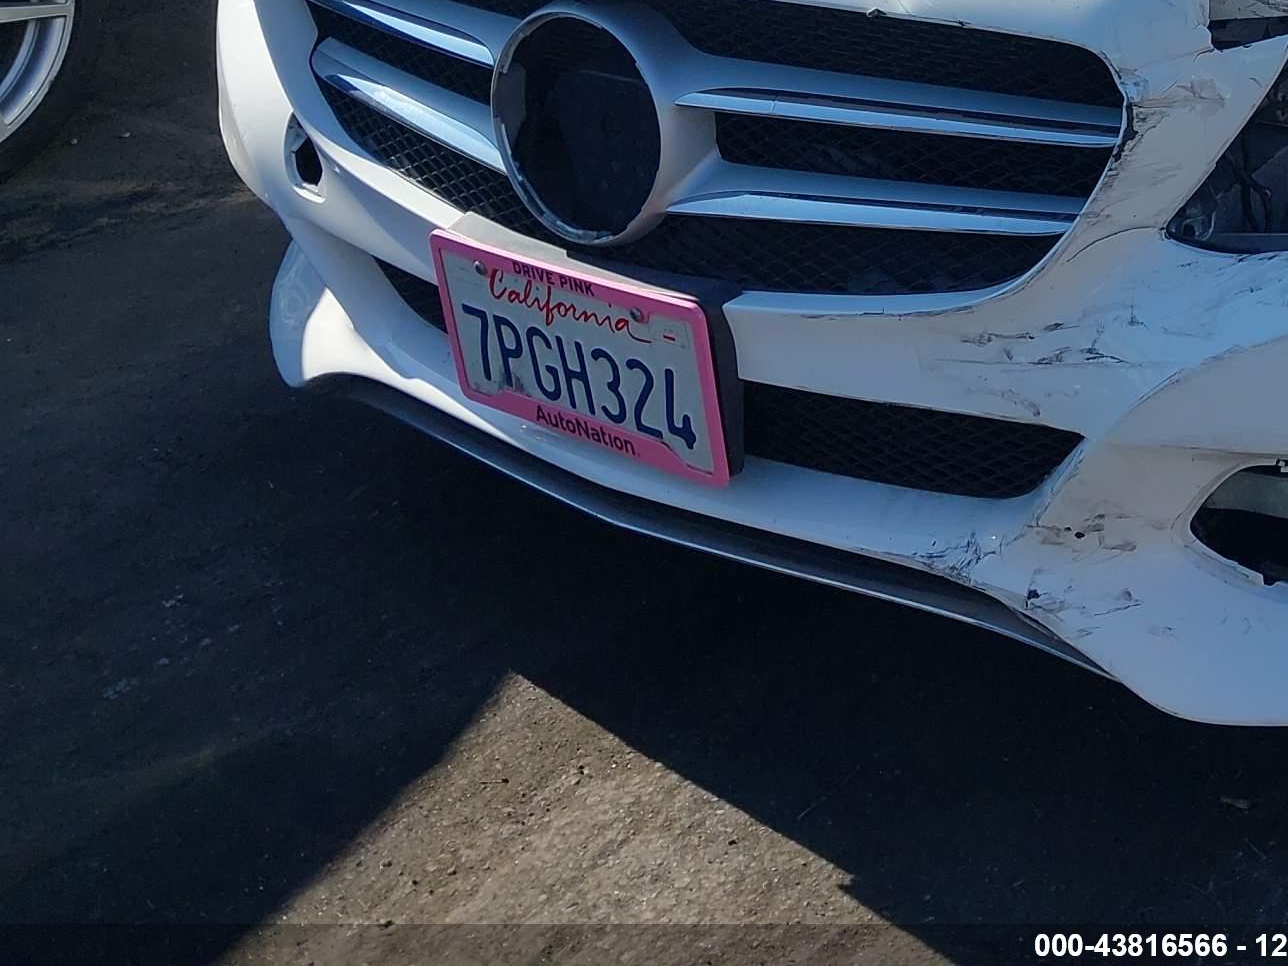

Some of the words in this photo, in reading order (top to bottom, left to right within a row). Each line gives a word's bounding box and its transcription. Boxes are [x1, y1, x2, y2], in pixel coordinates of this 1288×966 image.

[488, 268, 652, 344] California
[511, 261, 555, 286] DRIVE
[558, 274, 595, 297] PINK
[462, 303, 697, 450] 7PGH324
[535, 405, 637, 457] AutoNation
